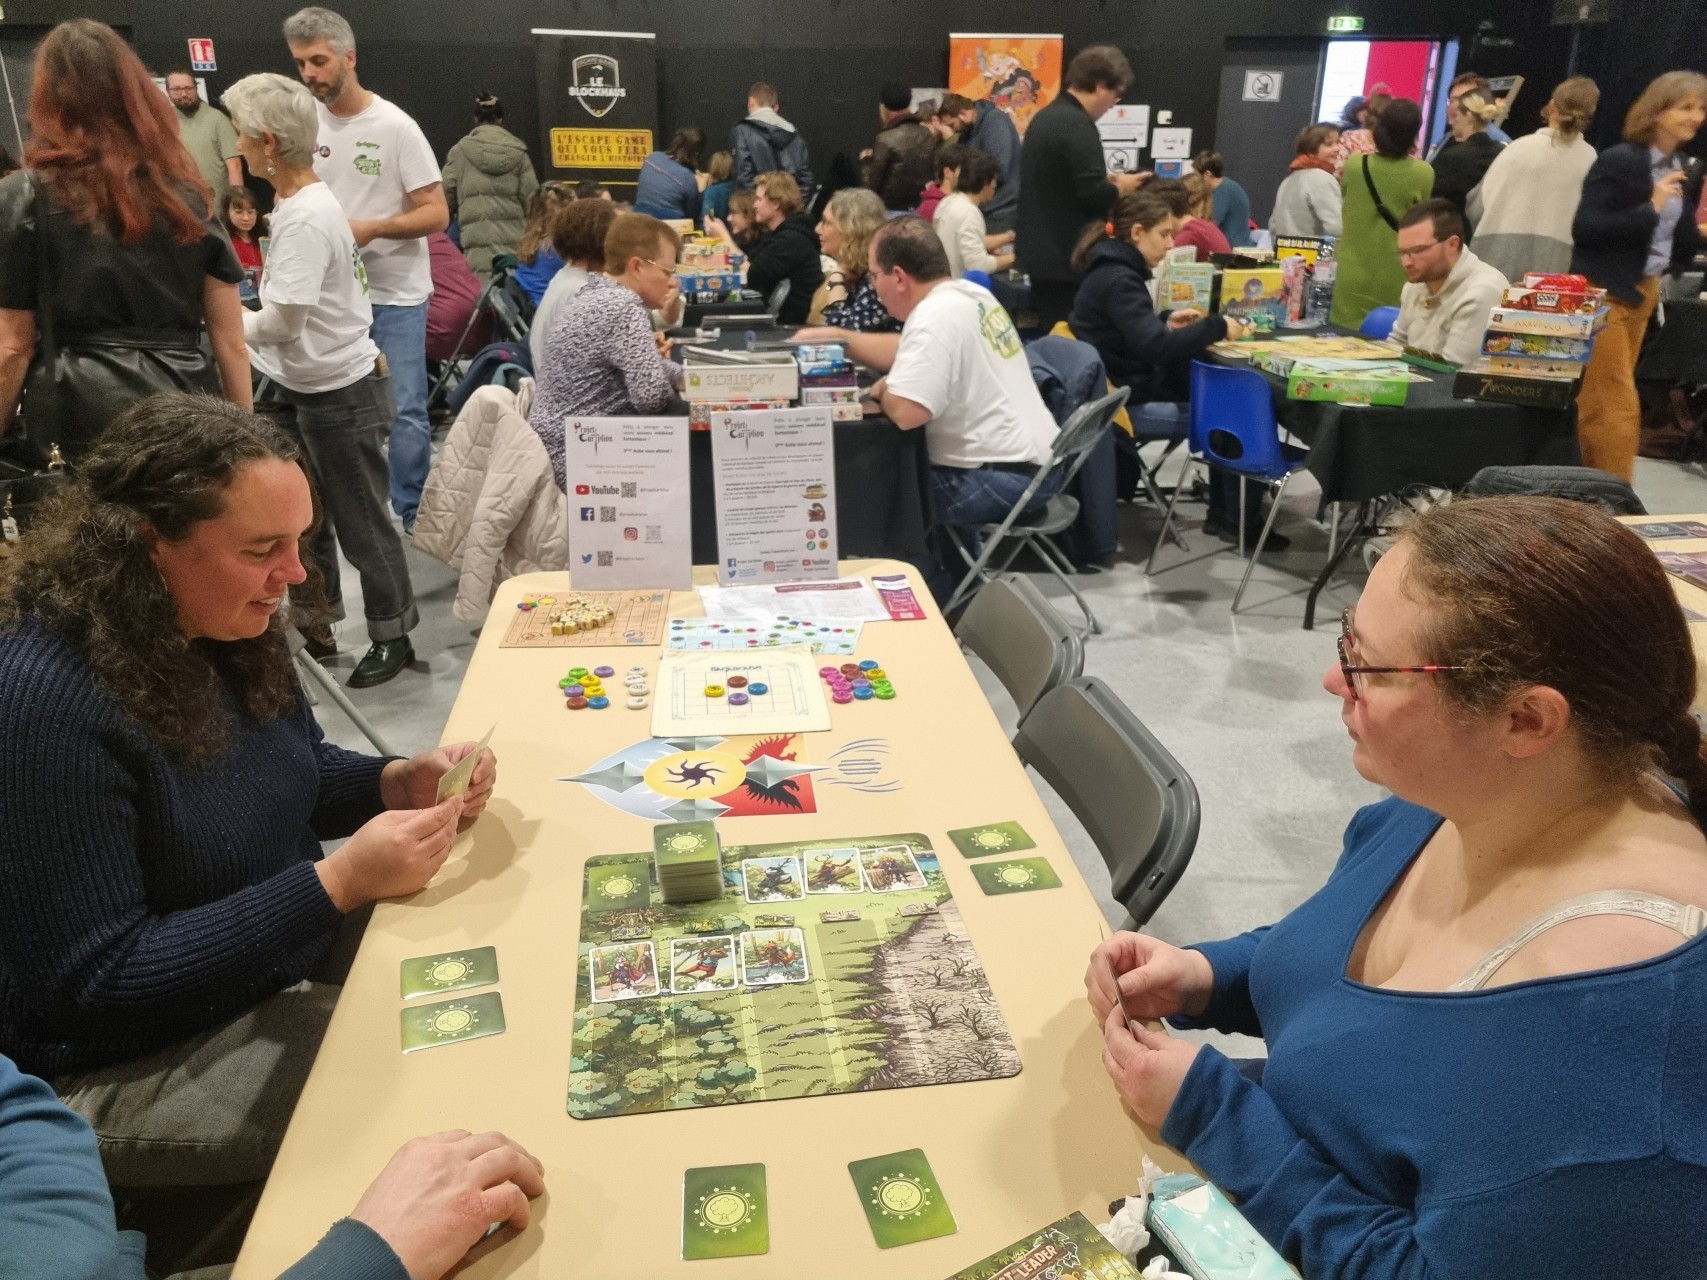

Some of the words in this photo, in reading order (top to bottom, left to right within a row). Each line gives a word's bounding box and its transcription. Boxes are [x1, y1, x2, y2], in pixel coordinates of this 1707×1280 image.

[590, 77, 604, 86] LE
[568, 86, 626, 97] BLOCKHAUS
[557, 135, 610, 145] L'ESCAPE
[616, 136, 647, 145] GAME
[557, 145, 578, 154] QUI
[583, 145, 612, 154] VOUS
[618, 145, 647, 155] FERA
[1479, 378, 1493, 397] 7
[1490, 384, 1542, 398] WONDERS
[591, 485, 620, 495] YouTube
[1016, 1245, 1058, 1277] LEADER
